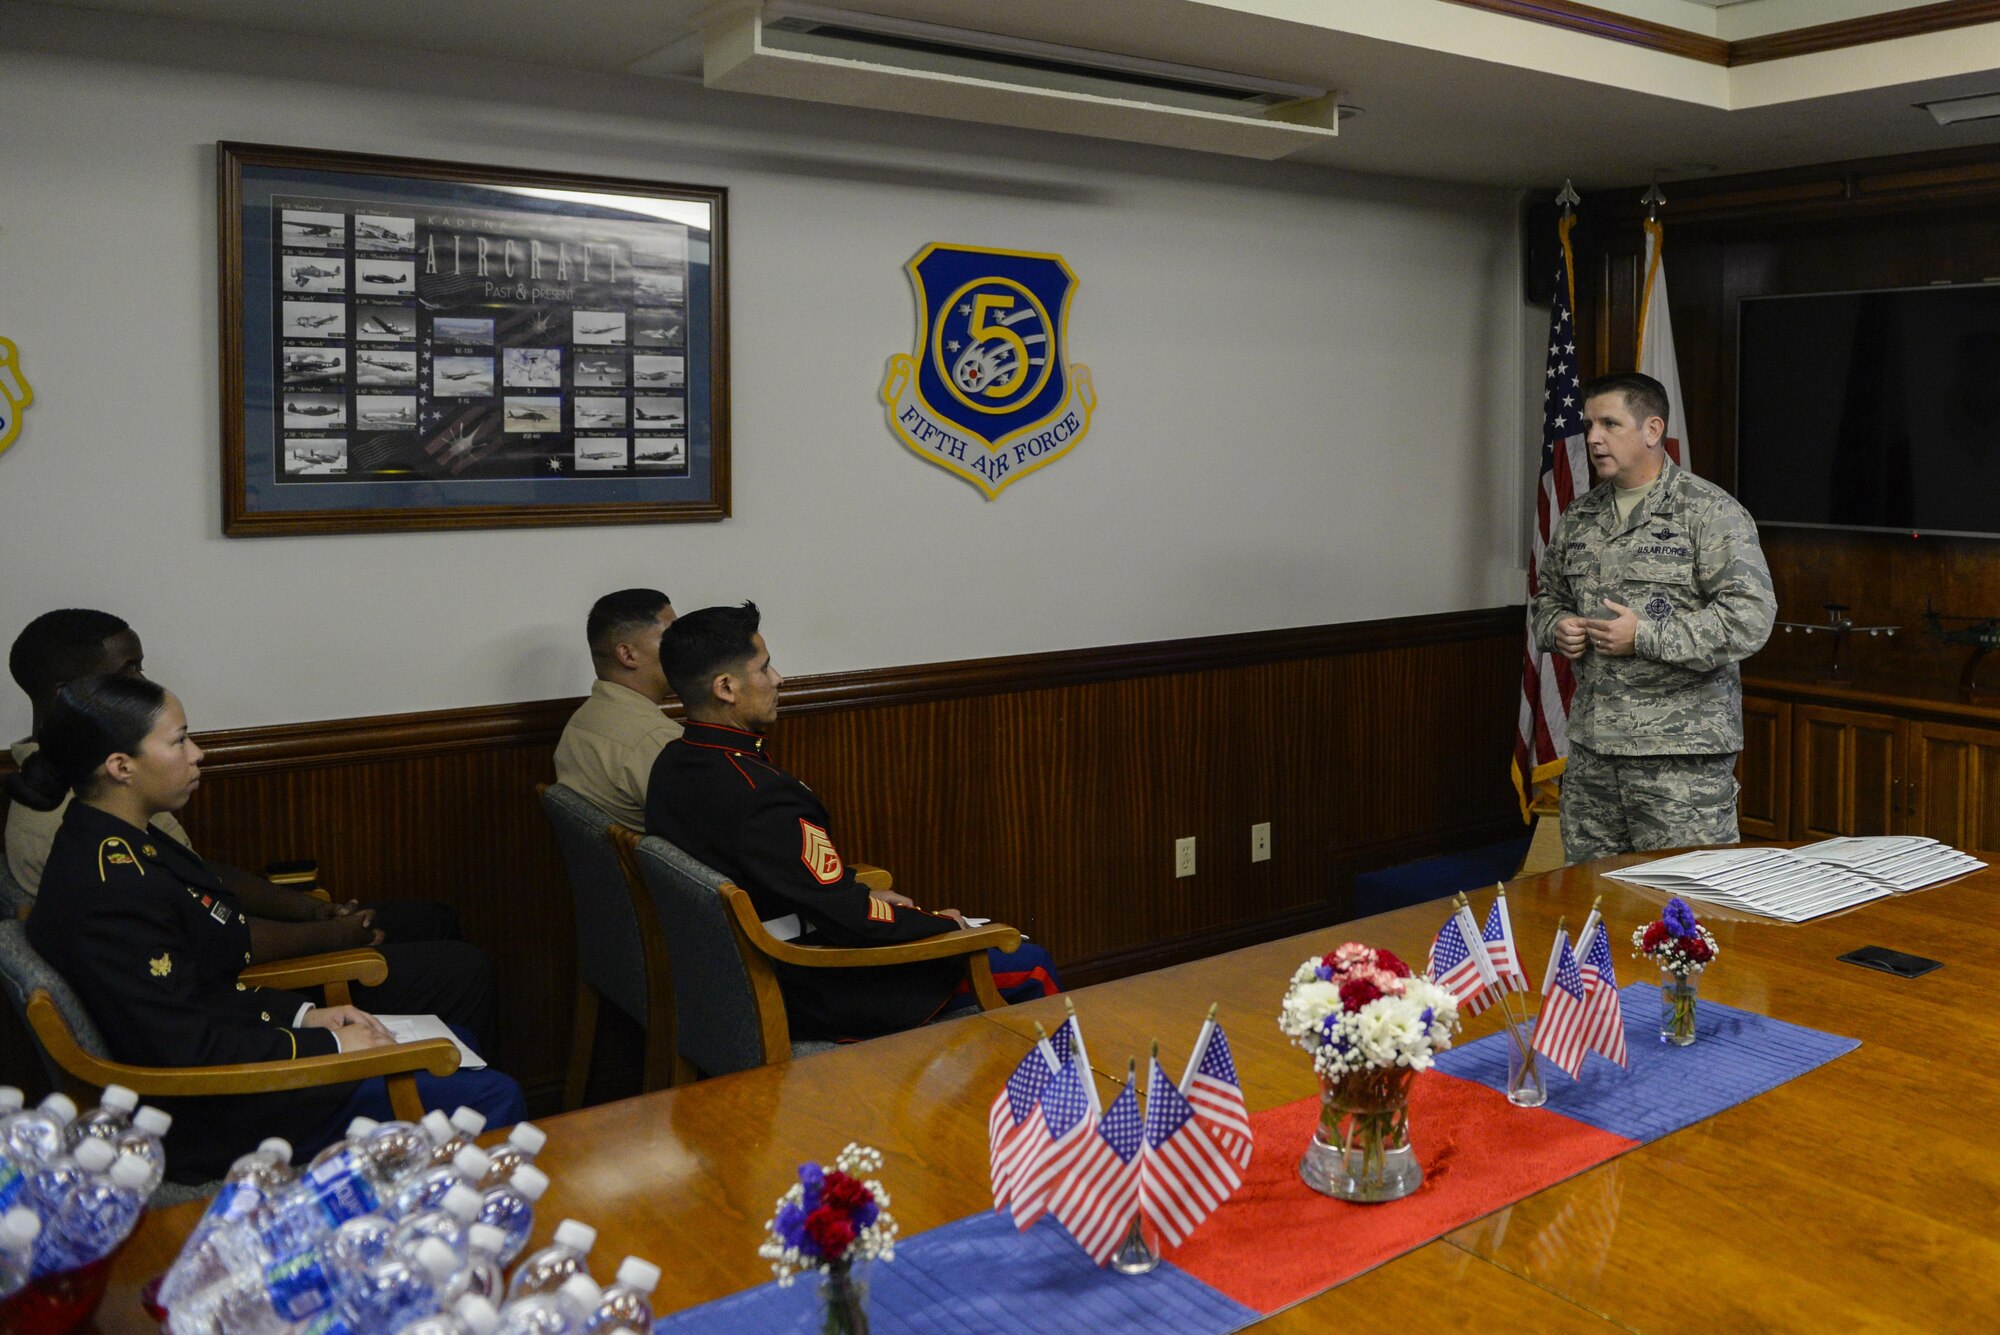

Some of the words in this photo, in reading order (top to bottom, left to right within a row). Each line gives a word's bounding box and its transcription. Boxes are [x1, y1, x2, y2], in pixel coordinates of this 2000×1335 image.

[425, 234, 618, 283] AIRCRAFT
[485, 281, 511, 299] PAST
[515, 282, 527, 300] &
[969, 293, 1029, 398] 5
[899, 405, 968, 461] FIFTH
[971, 453, 1010, 483] AIR
[1014, 411, 1081, 464] FORCE
[1661, 546, 1687, 557] FORCE
